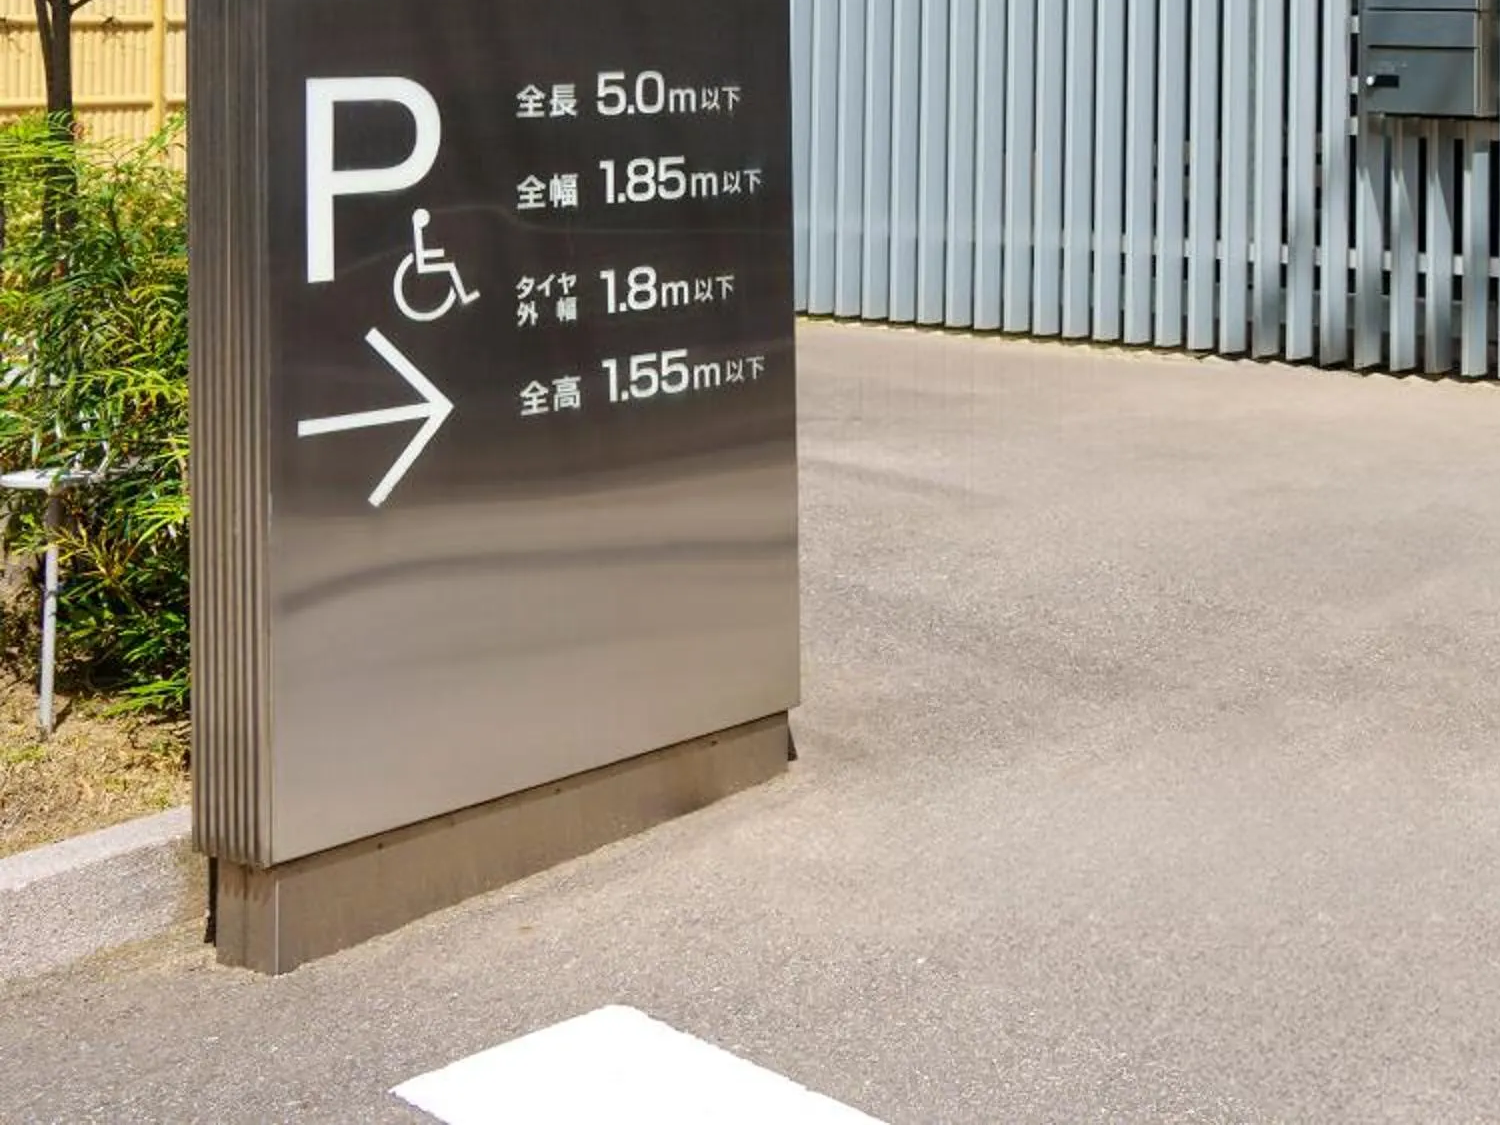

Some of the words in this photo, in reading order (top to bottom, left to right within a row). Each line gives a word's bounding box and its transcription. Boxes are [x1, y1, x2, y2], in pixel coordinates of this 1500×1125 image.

[517, 83, 578, 119] 全長
[305, 76, 442, 283] P
[516, 174, 578, 210] 全幅
[516, 272, 577, 299] タイヤ
[519, 375, 582, 416] 全高
